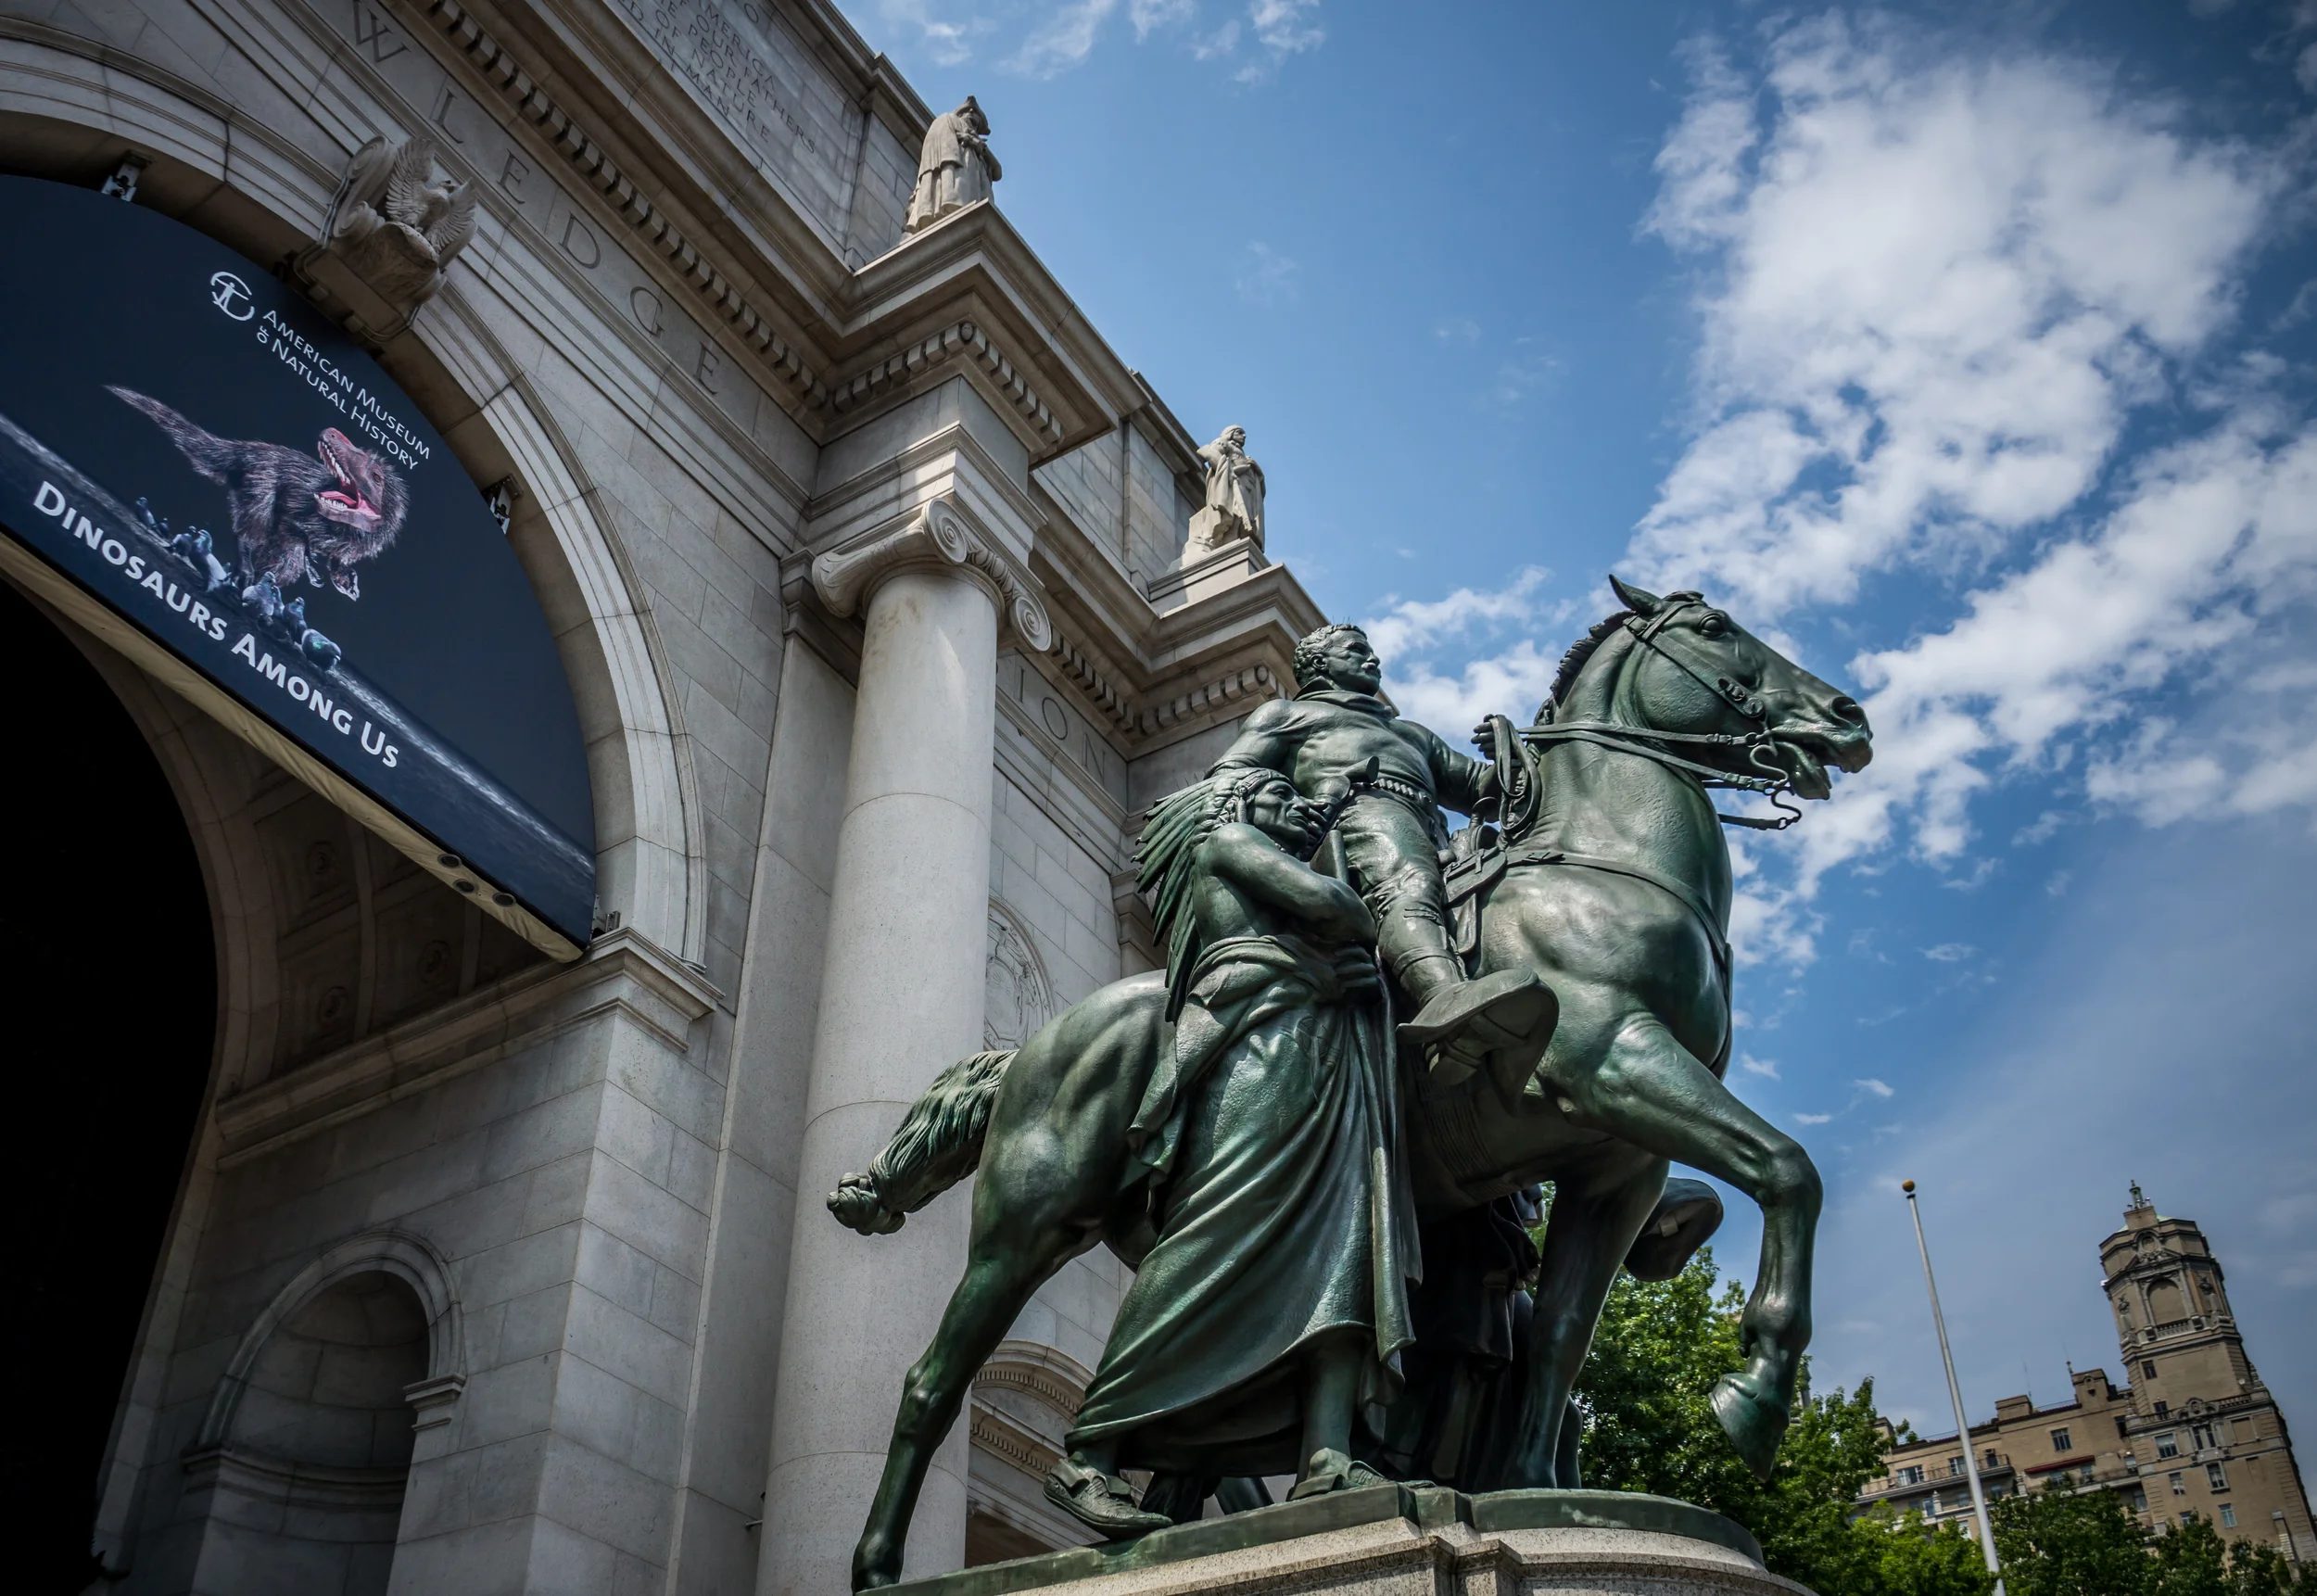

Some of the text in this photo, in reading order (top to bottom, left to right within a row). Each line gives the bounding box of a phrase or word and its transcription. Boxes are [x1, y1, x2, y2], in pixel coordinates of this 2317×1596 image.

[655, 27, 676, 56] IN
[686, 64, 729, 117] MAN
[655, 9, 769, 143] OF NATURE
[689, 24, 756, 108] PEOPLE
[696, 14, 815, 154] OUR FATHERS
[256, 325, 419, 470] OF NATURAL HISTORY
[262, 310, 430, 460] AMERICAN MUSEUM
[33, 480, 399, 767] DINOSAURS AMONG US
[995, 661, 1107, 787] ION
